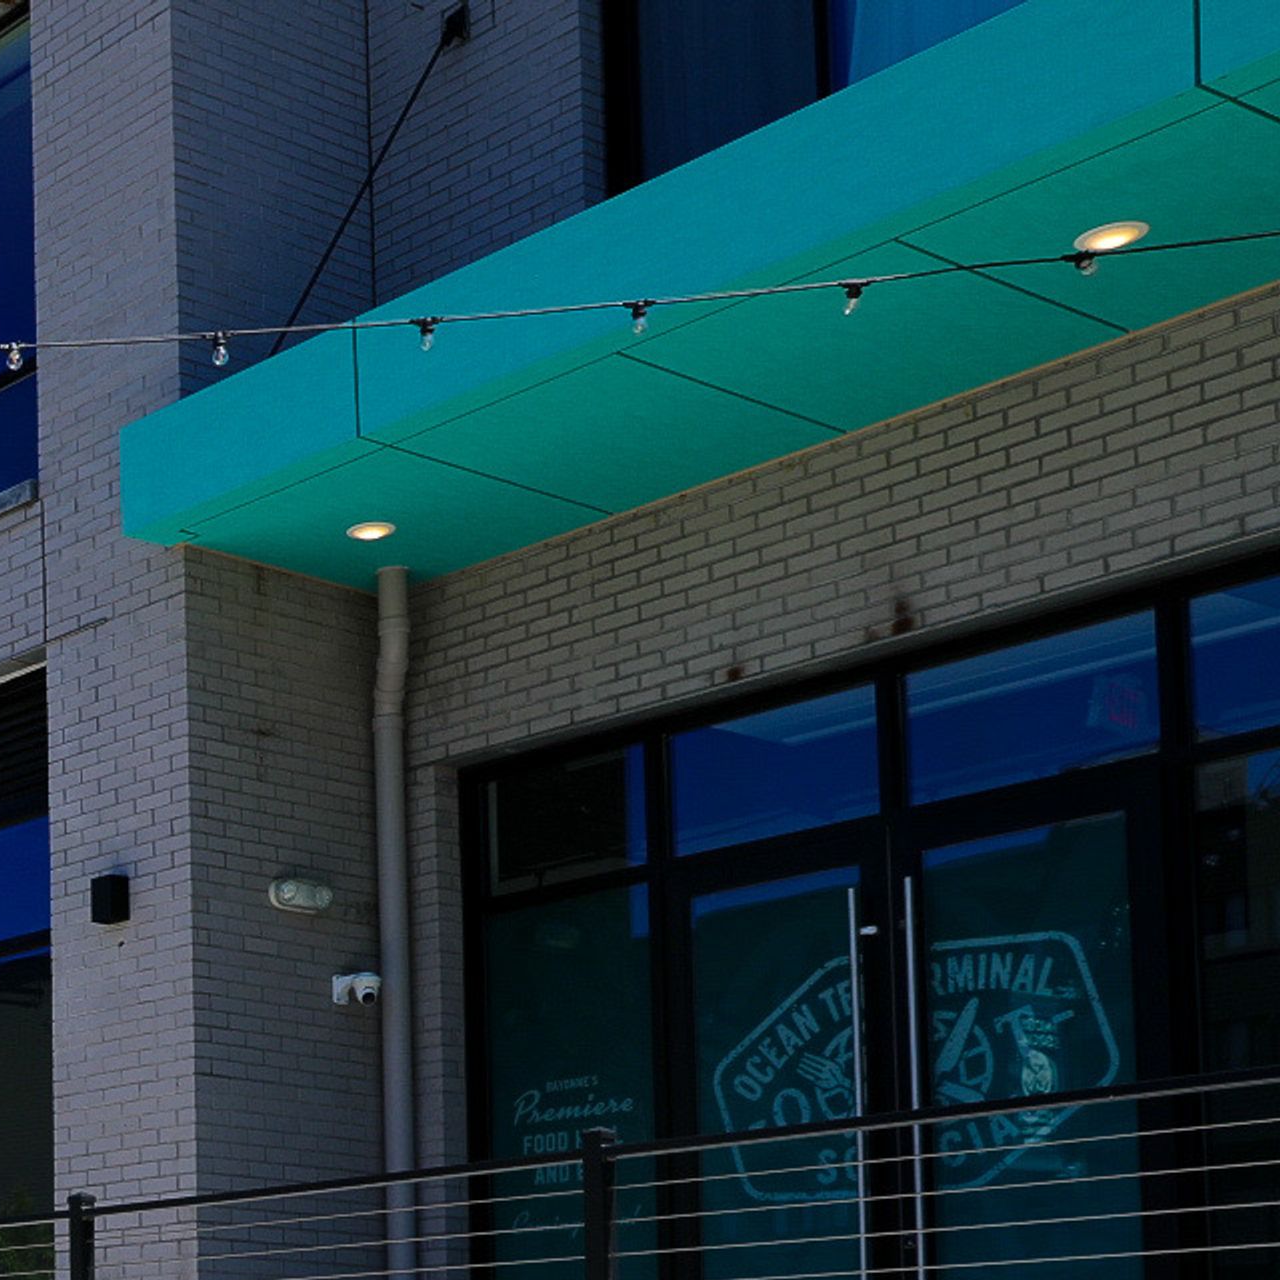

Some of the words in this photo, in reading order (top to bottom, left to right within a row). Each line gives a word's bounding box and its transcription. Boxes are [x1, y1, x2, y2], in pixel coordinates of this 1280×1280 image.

[734, 1003, 820, 1102] OCEAN
[513, 1090, 635, 1127] Premiere
[523, 1131, 569, 1156] FOOD
[534, 1166, 570, 1186] AND
